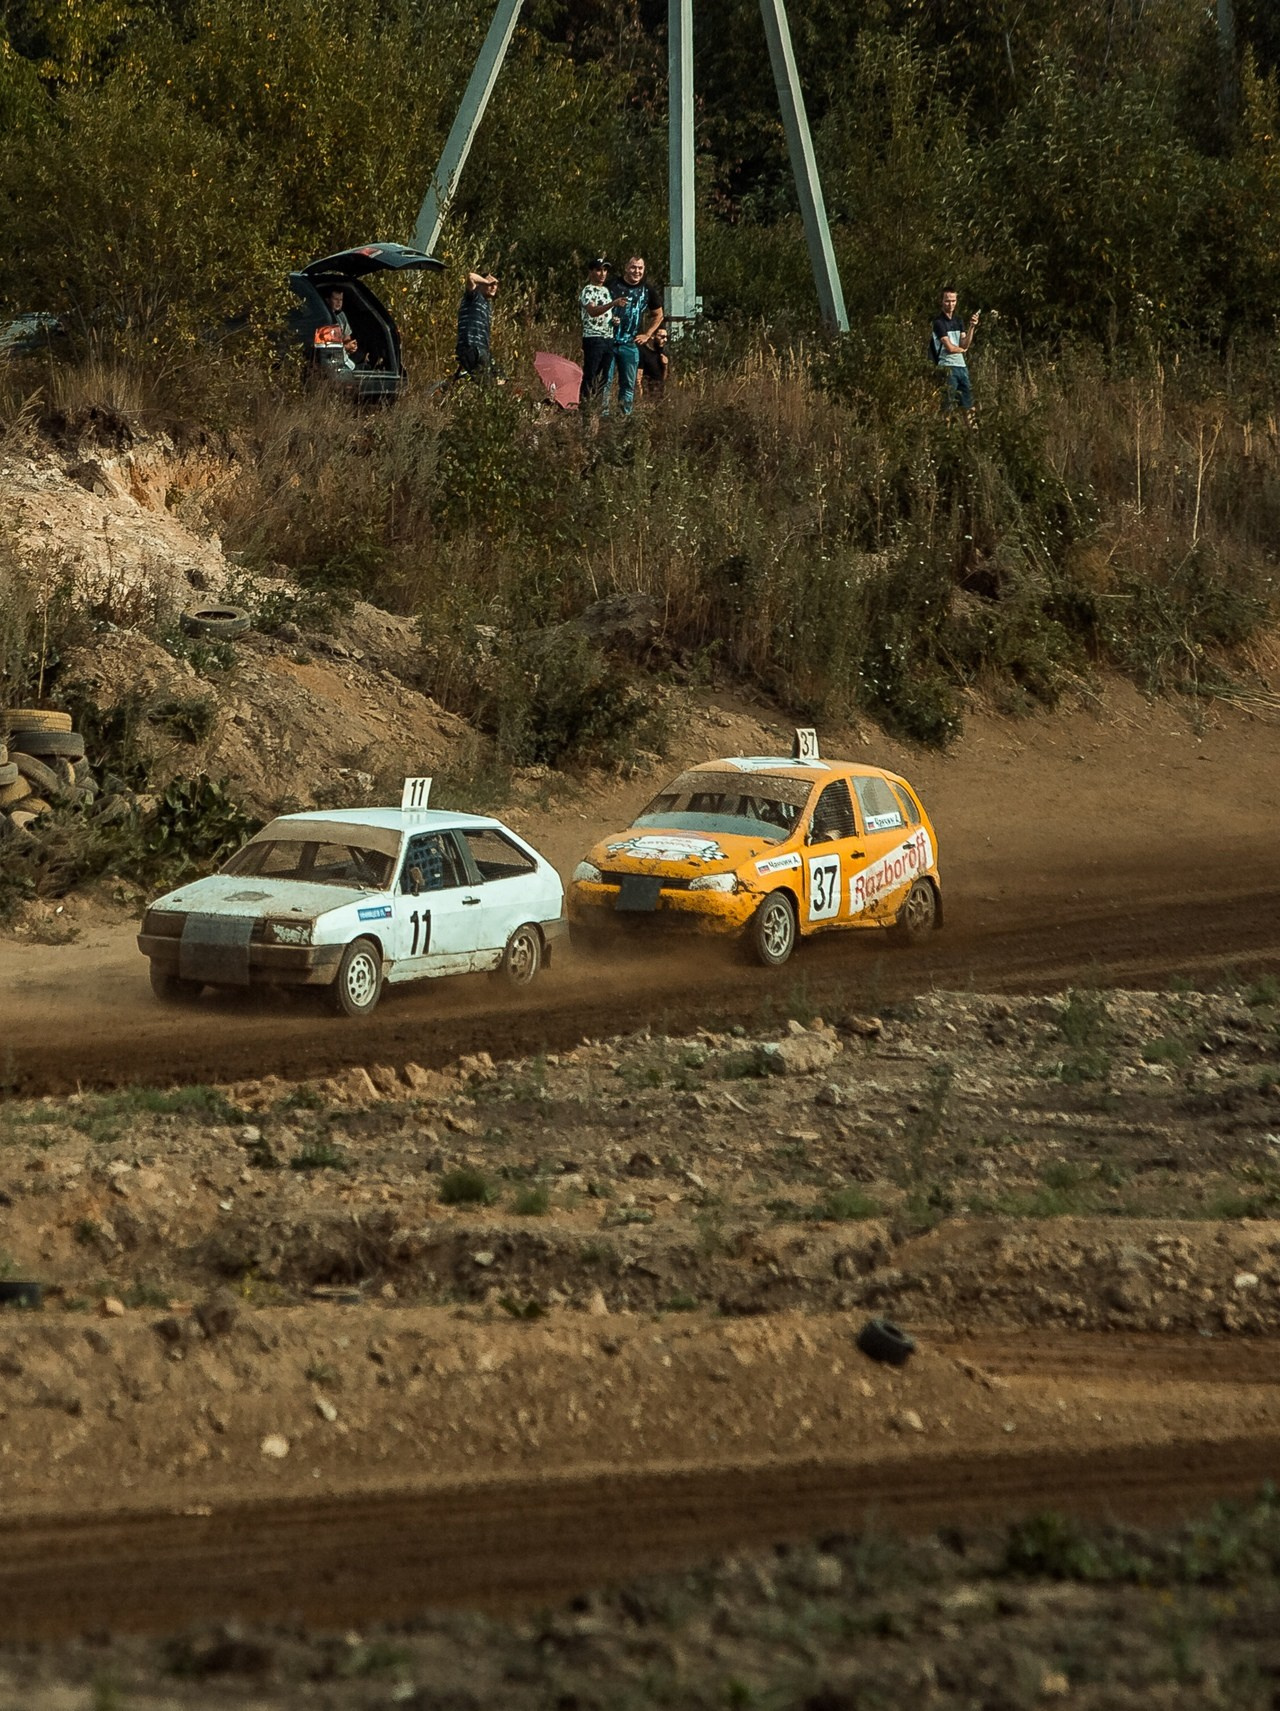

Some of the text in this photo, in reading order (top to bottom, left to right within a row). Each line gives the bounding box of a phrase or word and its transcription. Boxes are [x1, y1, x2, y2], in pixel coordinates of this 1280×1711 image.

[800, 731, 815, 756] 37
[411, 779, 426, 807] 11
[813, 865, 838, 912] 37
[854, 831, 927, 905] Razboroff
[410, 909, 432, 955] 11
